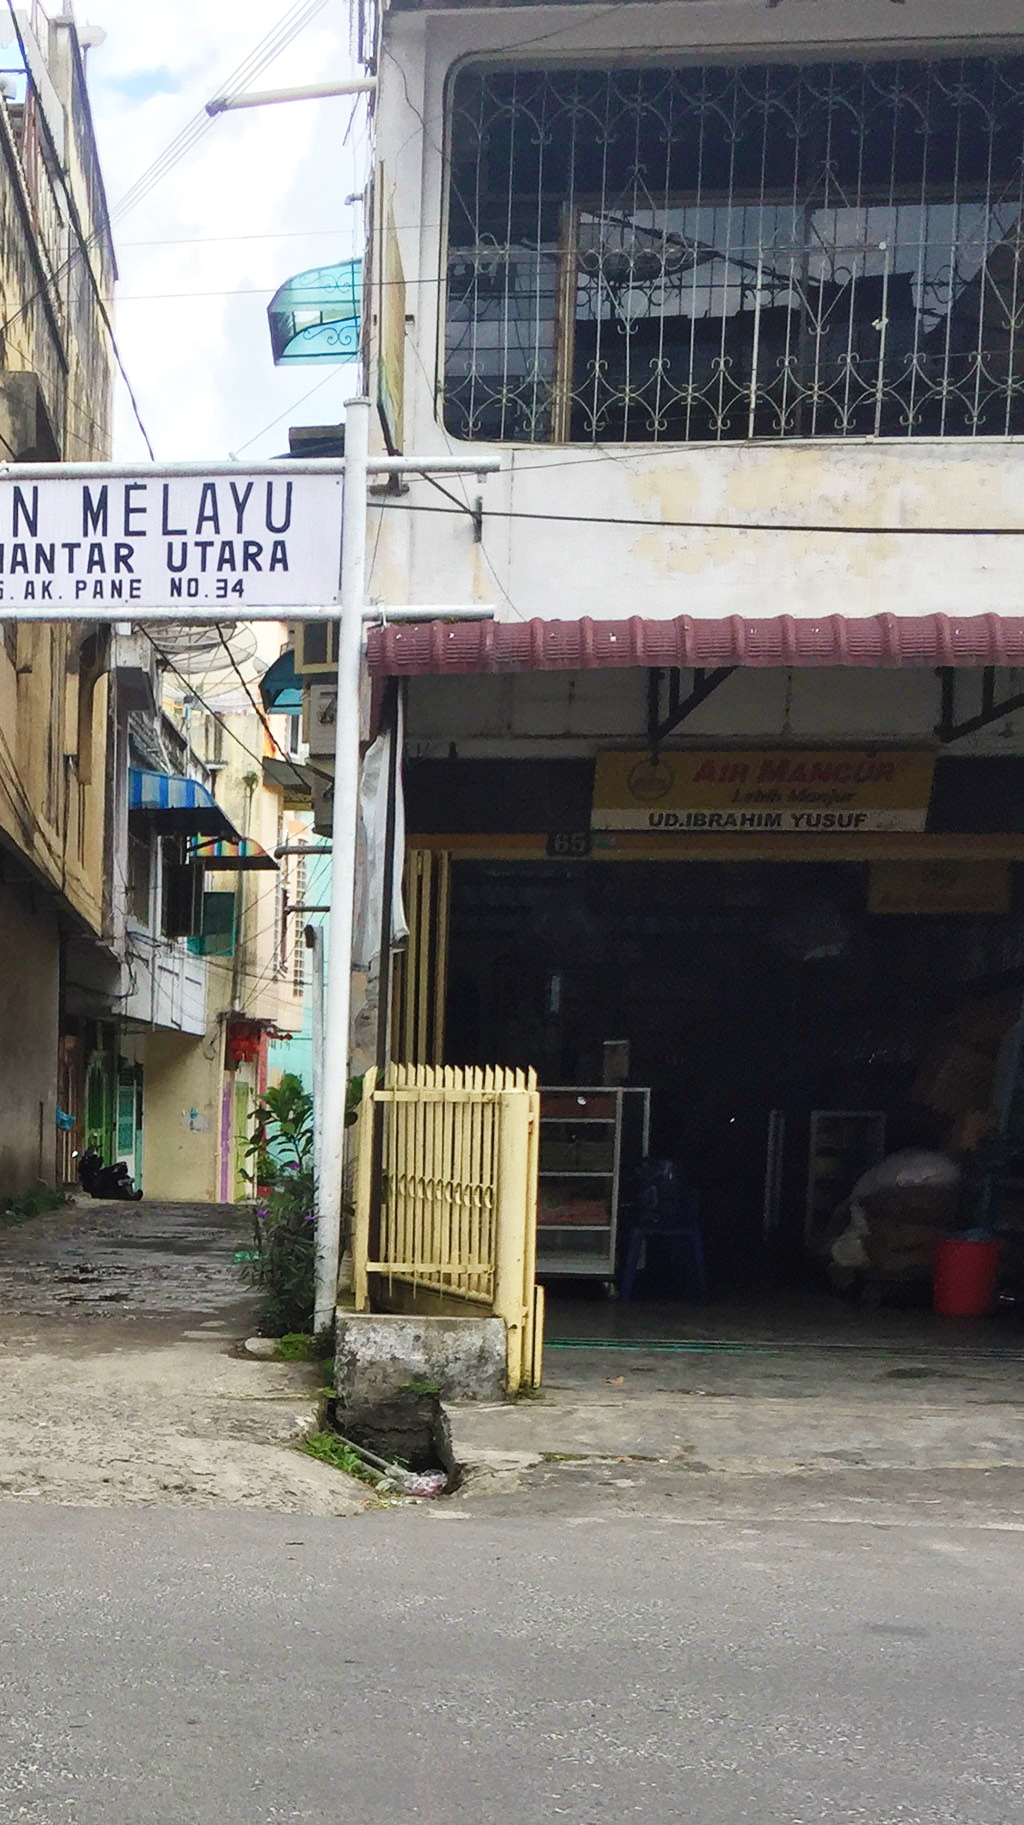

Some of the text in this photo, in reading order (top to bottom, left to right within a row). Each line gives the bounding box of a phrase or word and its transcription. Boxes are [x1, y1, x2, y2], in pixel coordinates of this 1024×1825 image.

[82, 481, 293, 537] MELAYU
[166, 540, 289, 573] UTARA
[648, 812, 868, 828] UD.IBRAHIM YUSUF
[552, 834, 586, 854] 65
